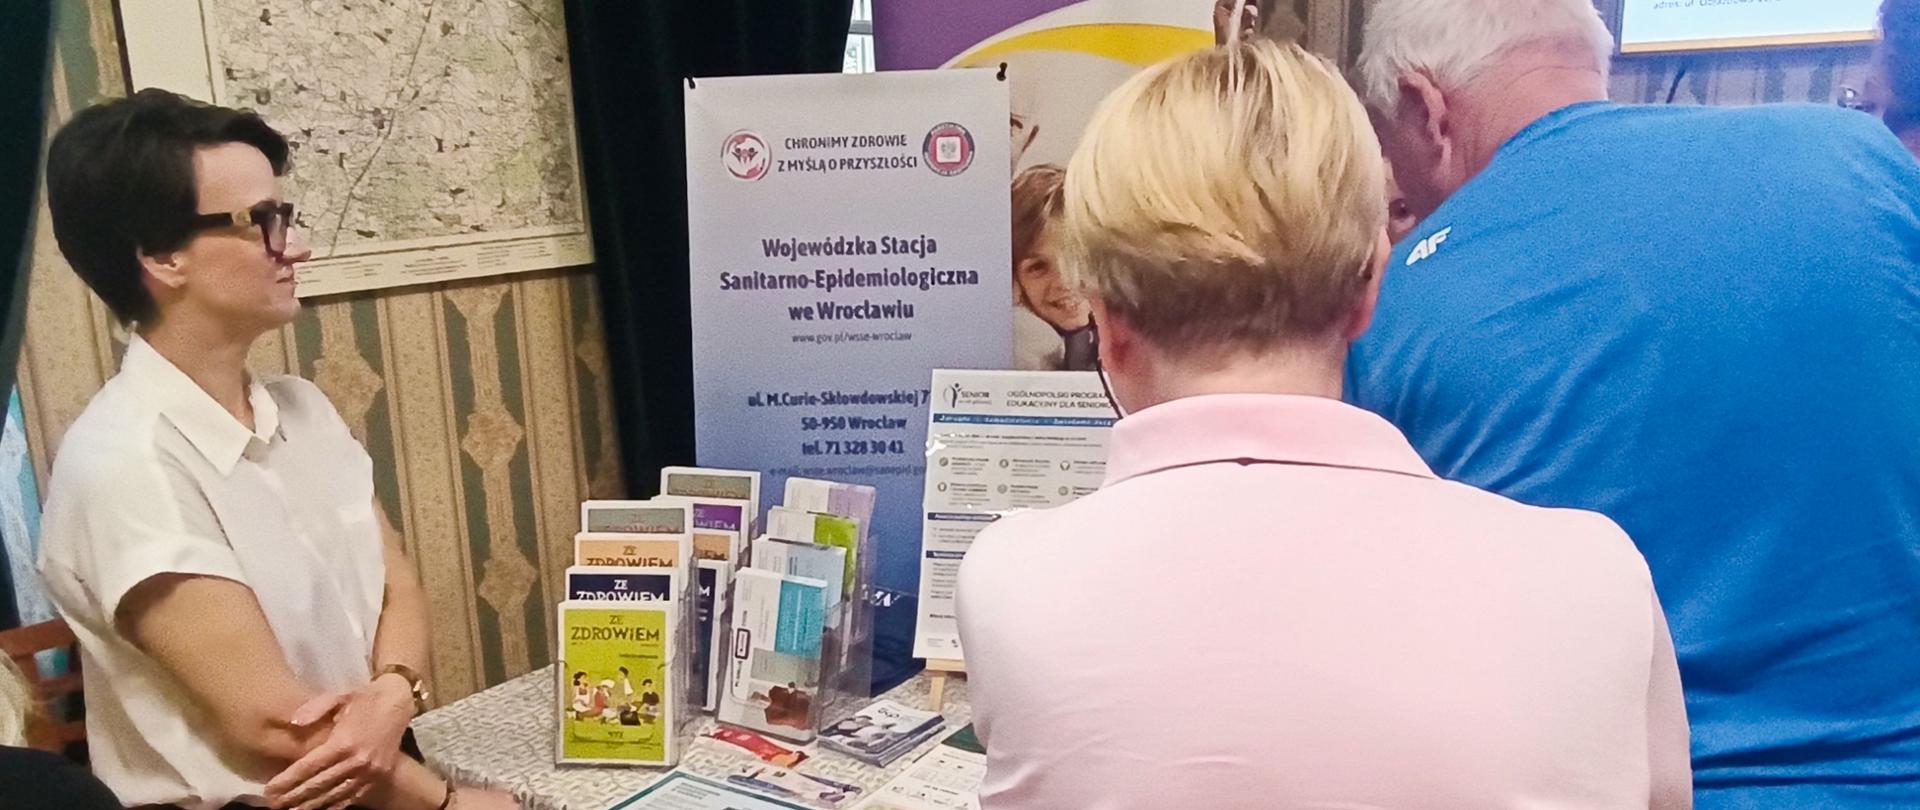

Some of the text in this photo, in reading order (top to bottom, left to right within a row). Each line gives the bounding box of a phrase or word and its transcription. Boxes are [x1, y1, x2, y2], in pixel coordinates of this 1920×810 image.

[785, 134, 908, 150] CHRONIMY ZDROWIE
[777, 160, 785, 172] Z
[787, 157, 827, 174] MYŚLĄ
[828, 159, 838, 170] O
[840, 154, 918, 170] PRZYSZŁOŚCI
[762, 235, 937, 262] Wojewódzka Stacja
[720, 267, 979, 292] Sanitarno-Epidemiologiczna
[788, 300, 914, 321] we Wrocławiu
[748, 391, 764, 407] ul.
[801, 415, 907, 430] 50-950 Wrocław
[802, 441, 905, 455] tel. 71 328 30 41
[614, 579, 629, 590] ZE
[608, 614, 624, 625] ZE
